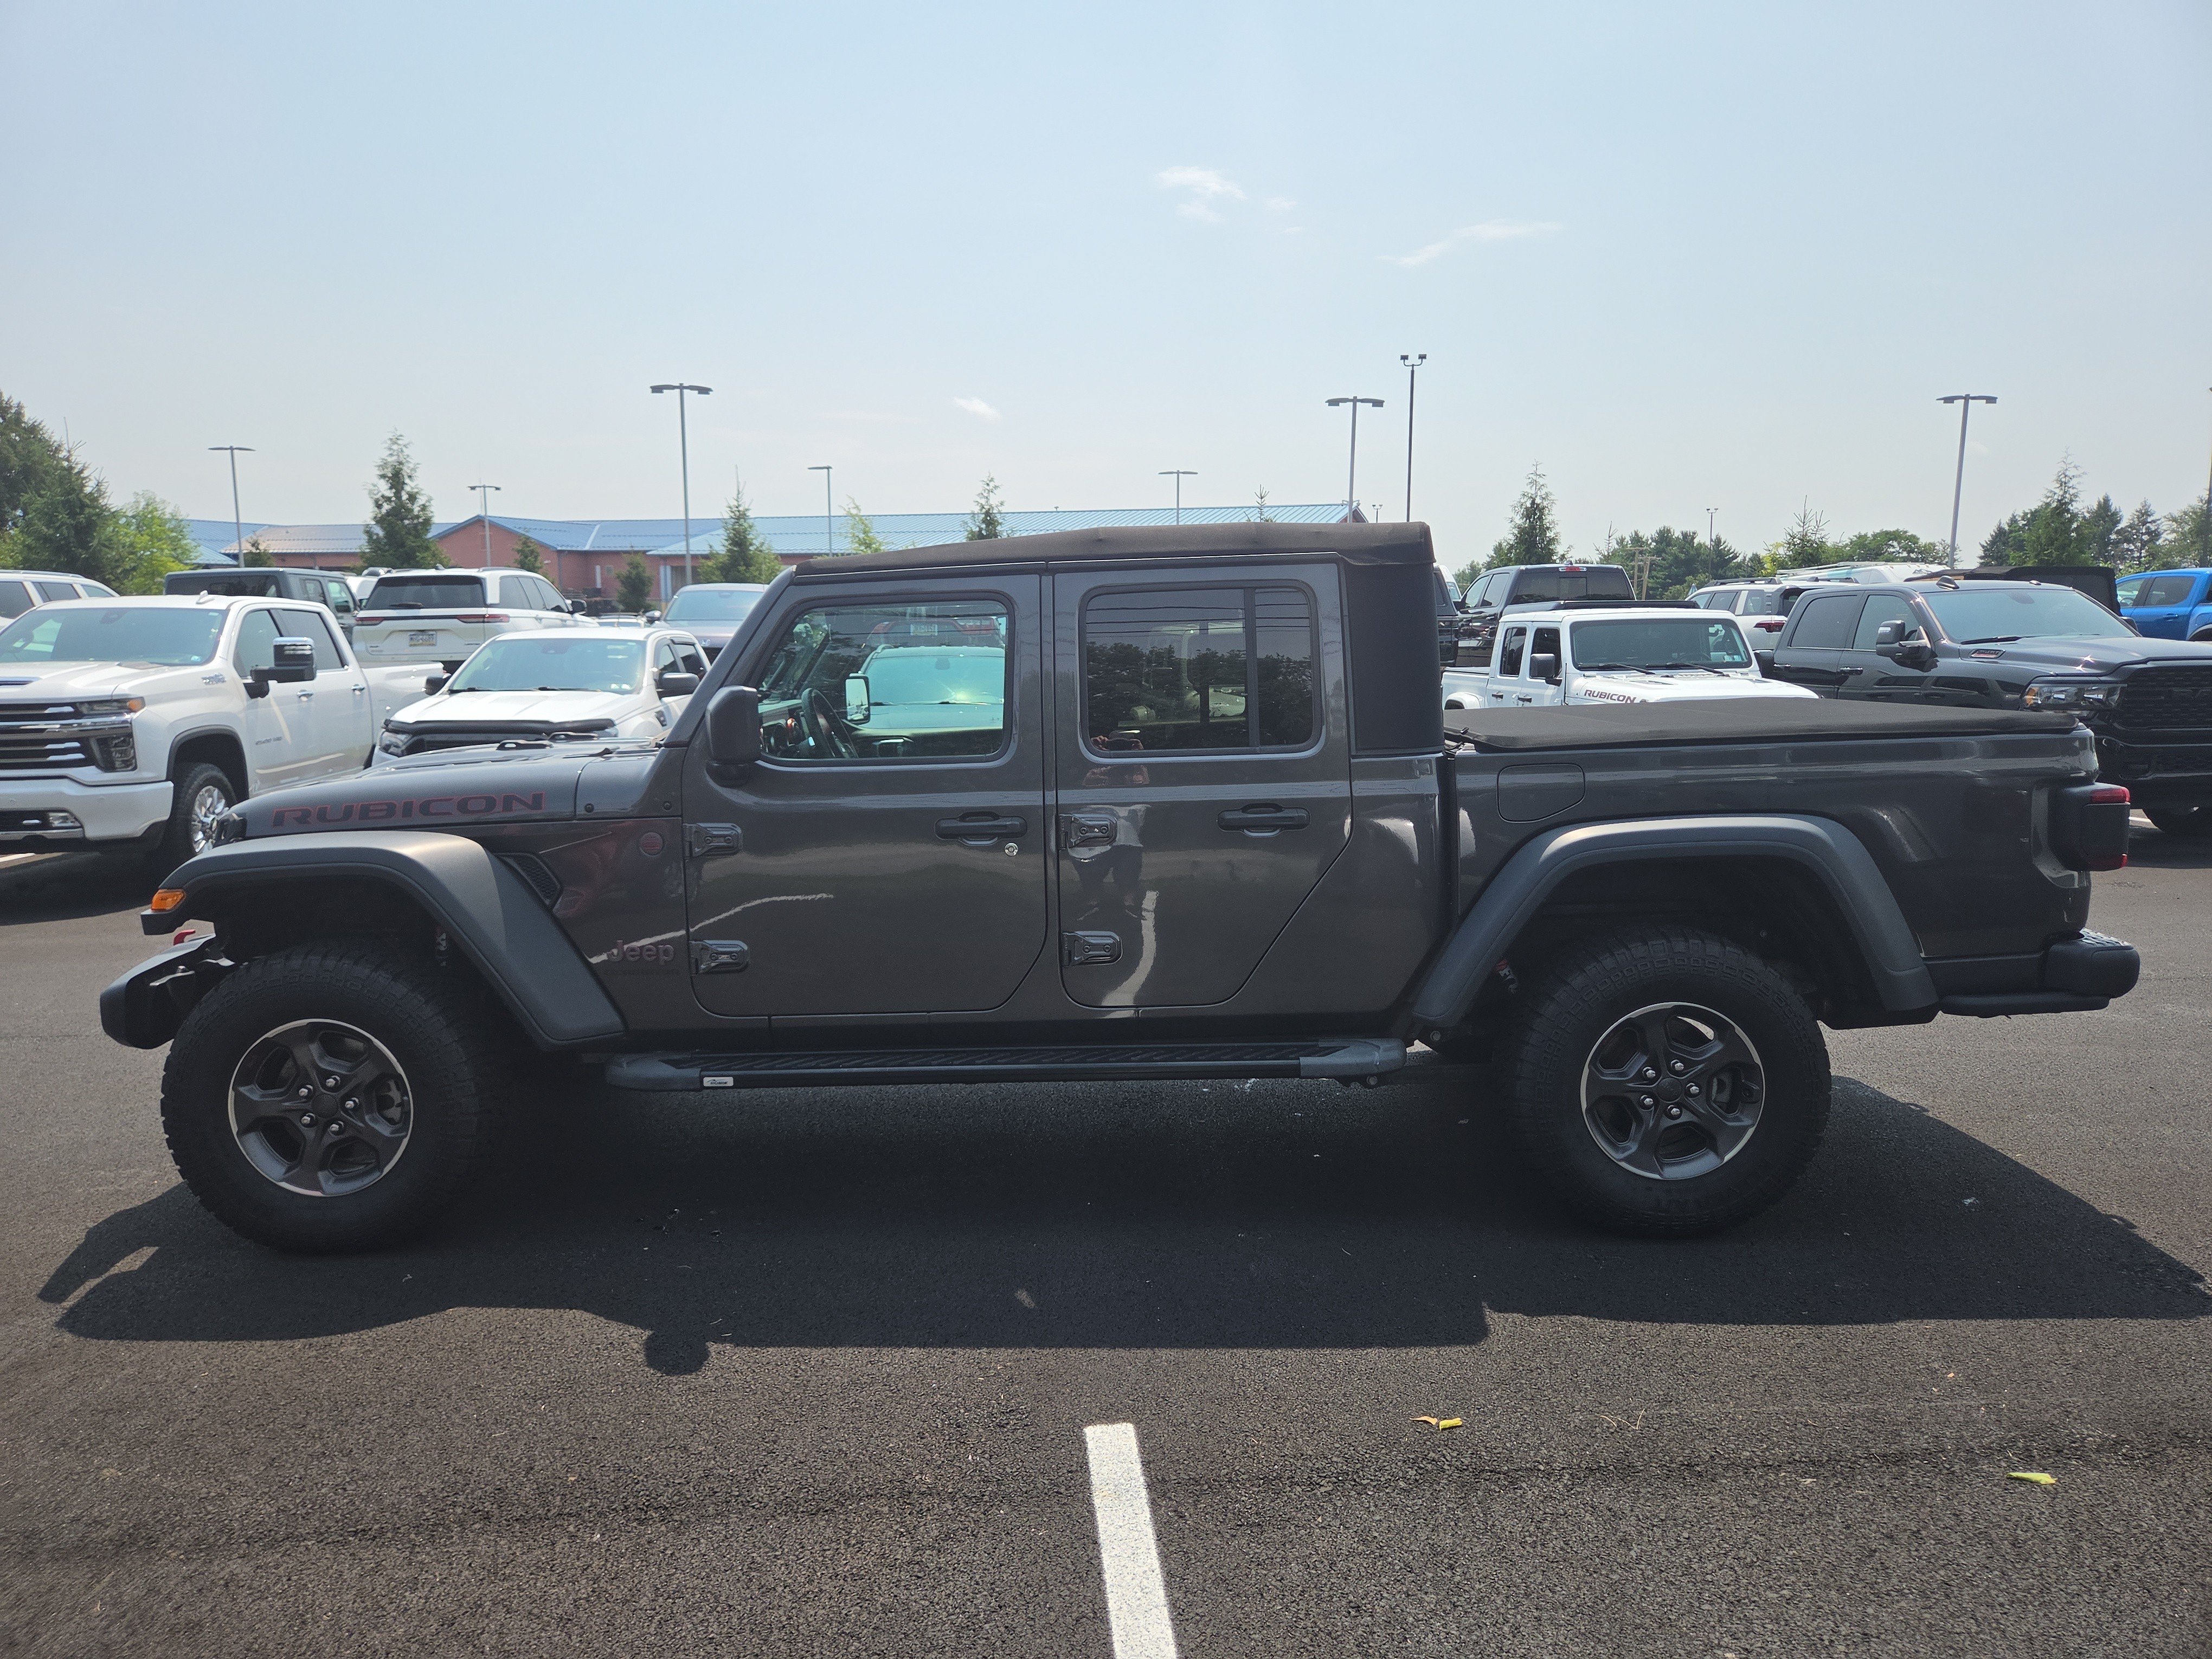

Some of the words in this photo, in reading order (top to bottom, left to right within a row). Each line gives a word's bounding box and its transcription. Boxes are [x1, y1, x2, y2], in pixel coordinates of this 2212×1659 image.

[1584, 690, 1637, 703] RUBICON
[272, 792, 545, 828] RUBICON
[607, 940, 674, 965] Jeep
